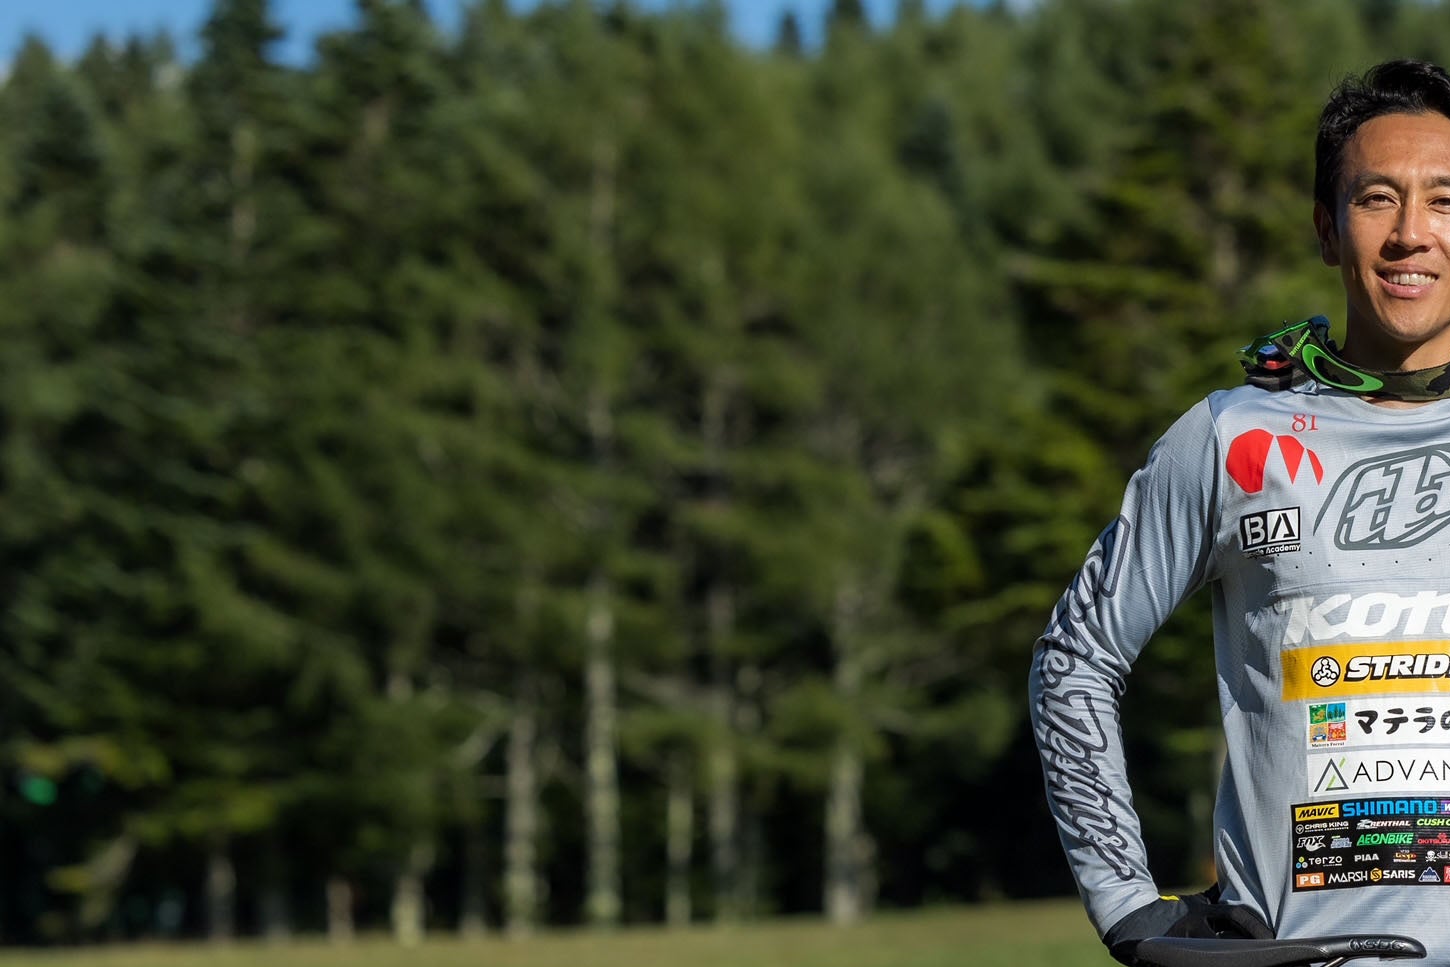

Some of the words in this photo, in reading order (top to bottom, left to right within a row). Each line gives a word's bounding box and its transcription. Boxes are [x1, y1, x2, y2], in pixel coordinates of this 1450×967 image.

[1291, 412, 1319, 432] 81
[1266, 543, 1301, 554] Academy
[1298, 806, 1336, 819] MAVIC
[1342, 800, 1437, 817] SHIMANO
[1304, 822, 1328, 830] CHRIS
[1328, 820, 1349, 828] KING
[1354, 853, 1379, 862] PIAA
[1328, 870, 1368, 884] MARSH
[1383, 869, 1416, 879] SARIS
[1300, 875, 1321, 885] PG
